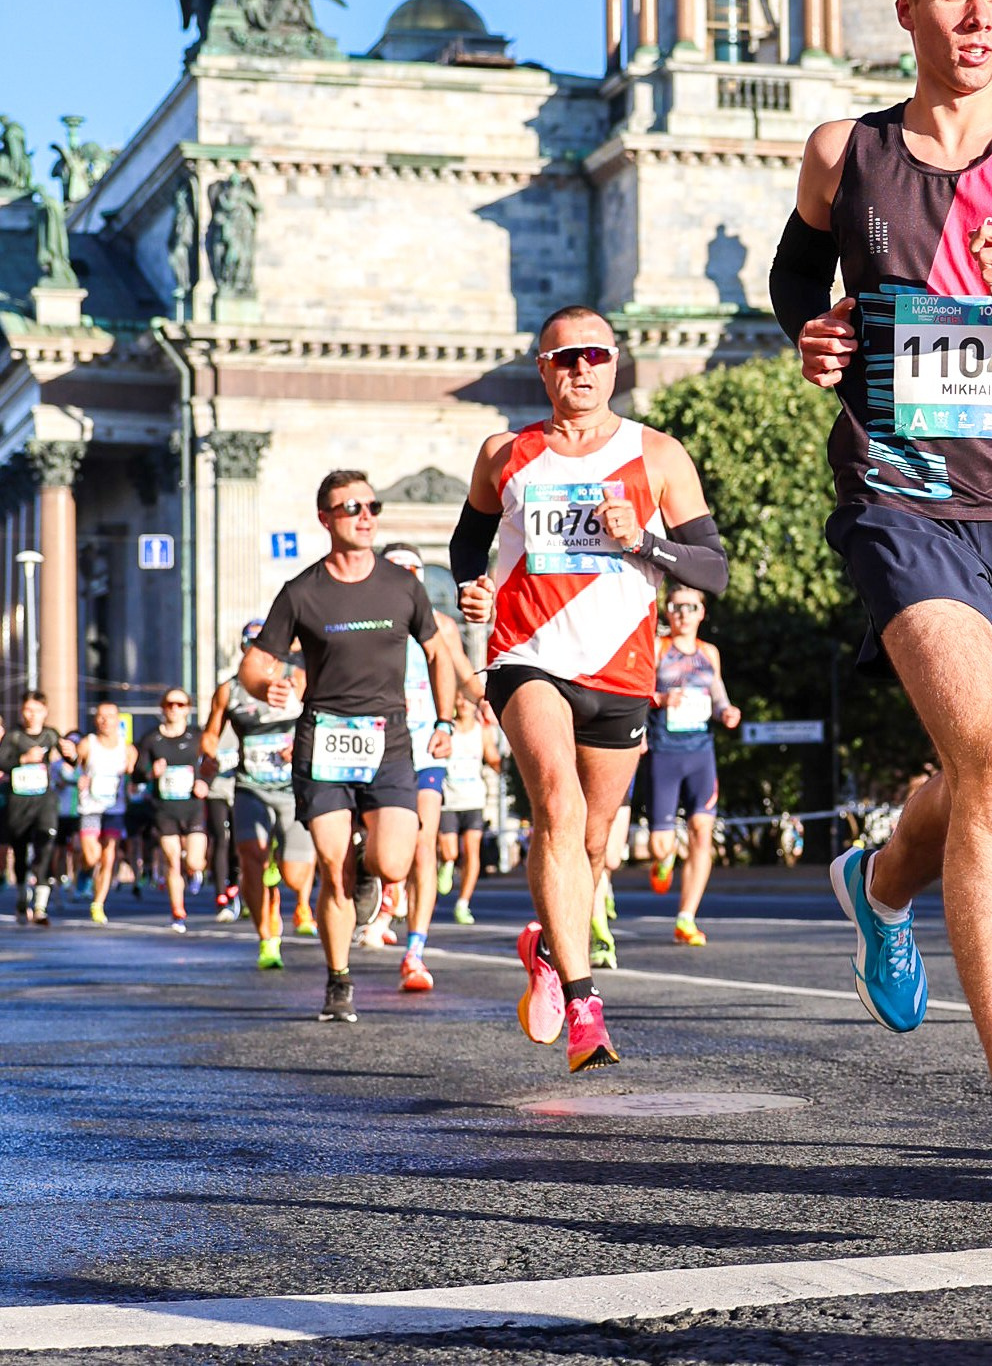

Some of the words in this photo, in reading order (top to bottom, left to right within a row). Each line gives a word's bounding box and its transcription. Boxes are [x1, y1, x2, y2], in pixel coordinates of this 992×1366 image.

[911, 297, 939, 306] ПОЛУ
[911, 306, 962, 315] МАРАФОН
[979, 306, 992, 316] 10
[530, 509, 609, 536] 1076
[546, 537, 601, 547] ALEXANDER
[325, 734, 376, 755] 8508
